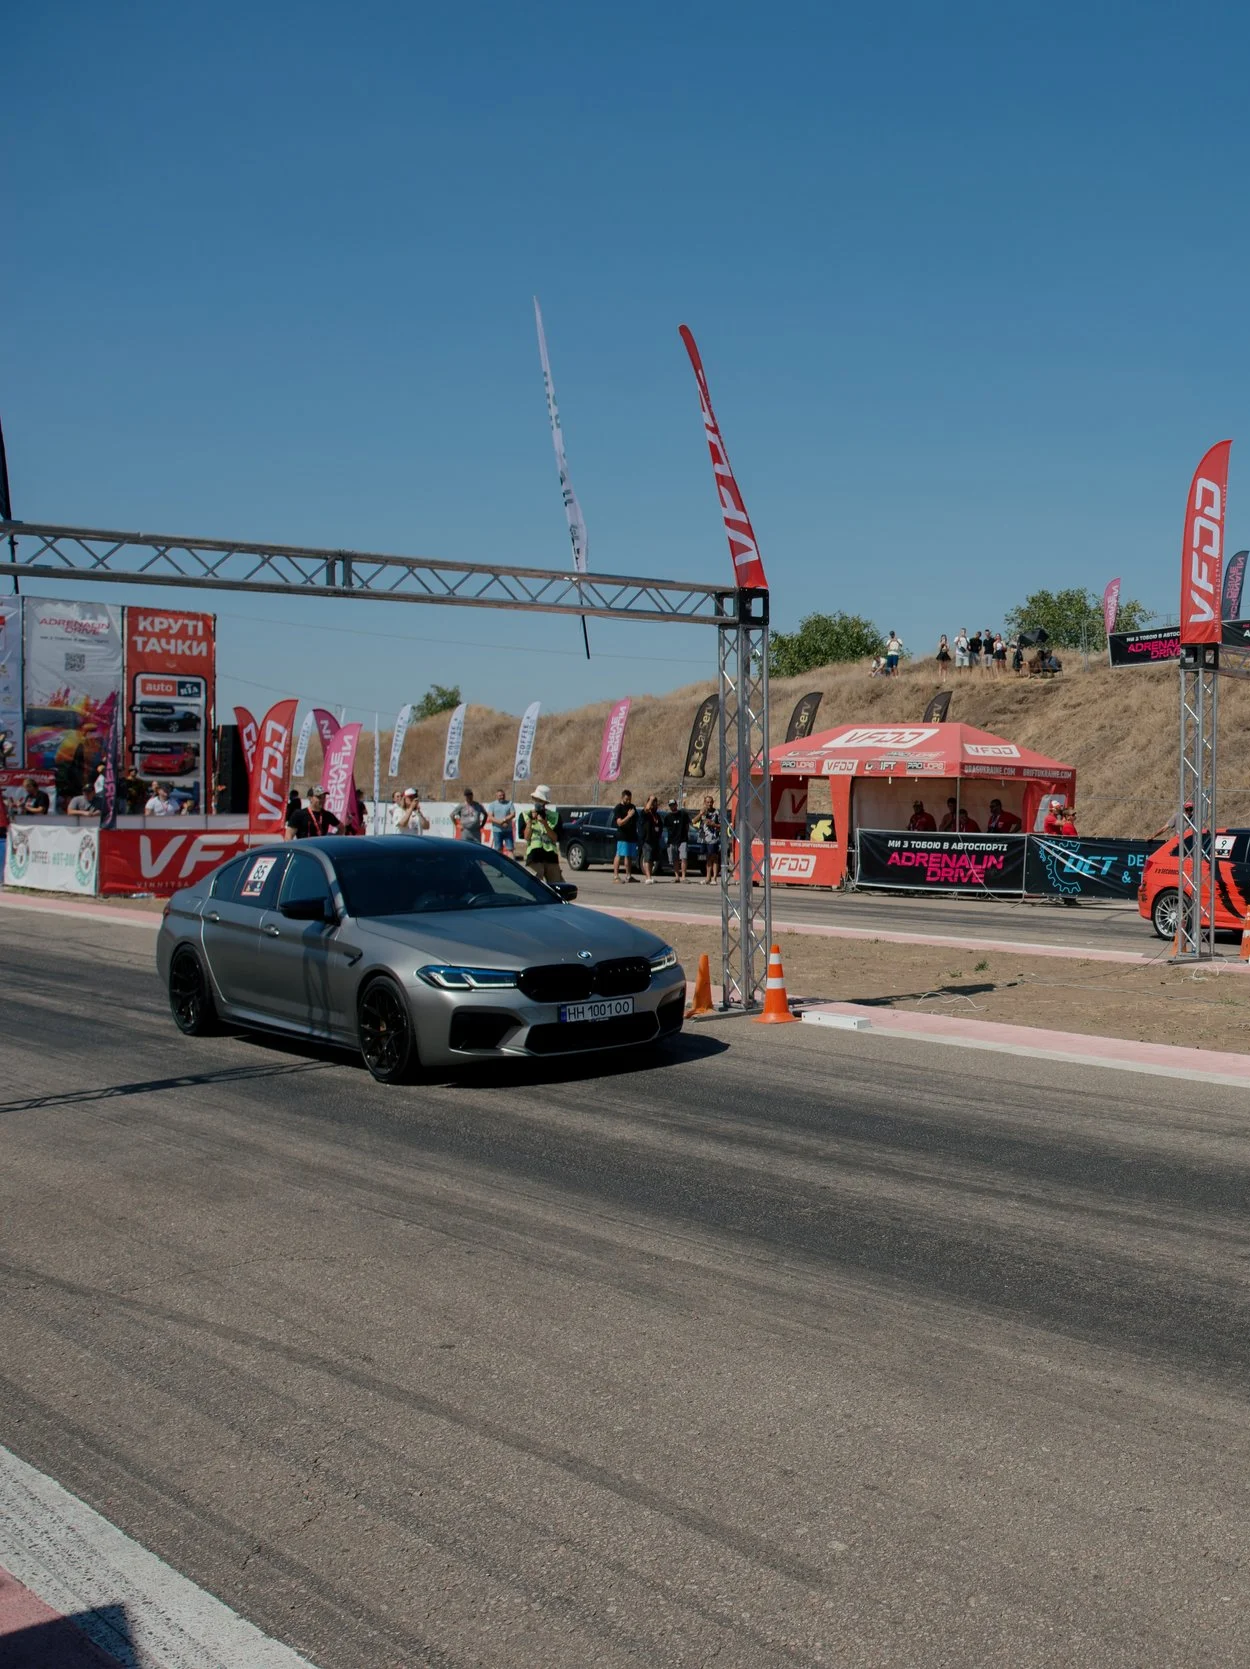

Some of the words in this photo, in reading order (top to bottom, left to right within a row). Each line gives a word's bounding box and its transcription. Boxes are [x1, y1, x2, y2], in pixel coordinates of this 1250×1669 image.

[1189, 477, 1221, 623] VFDD
[40, 618, 110, 629] ADRENALIN
[138, 615, 204, 637] КРУТІ
[132, 636, 208, 657] ТАЧКИ
[1128, 638, 1181, 653] ADRENAL
[145, 682, 173, 692] auto
[518, 723, 530, 755] COFFEE
[845, 731, 928, 744] VFDD
[968, 745, 1014, 755] VFDD
[257, 719, 288, 821] VFDD
[825, 761, 854, 771] VFDD
[887, 839, 901, 848] МИ
[902, 840, 910, 849] З
[910, 840, 942, 850] ТОБОЮ
[943, 841, 949, 850] В
[950, 842, 1008, 852] АВТОСПОРТІ
[1221, 839, 1228, 849] 9
[887, 852, 1005, 869] ADRENALIN
[1063, 855, 1118, 876] DCT
[253, 864, 268, 880] 85
[925, 867, 985, 883] DRIVE
[1122, 871, 1131, 883] &
[567, 1006, 585, 1019] HH
[587, 1002, 613, 1017] 1001
